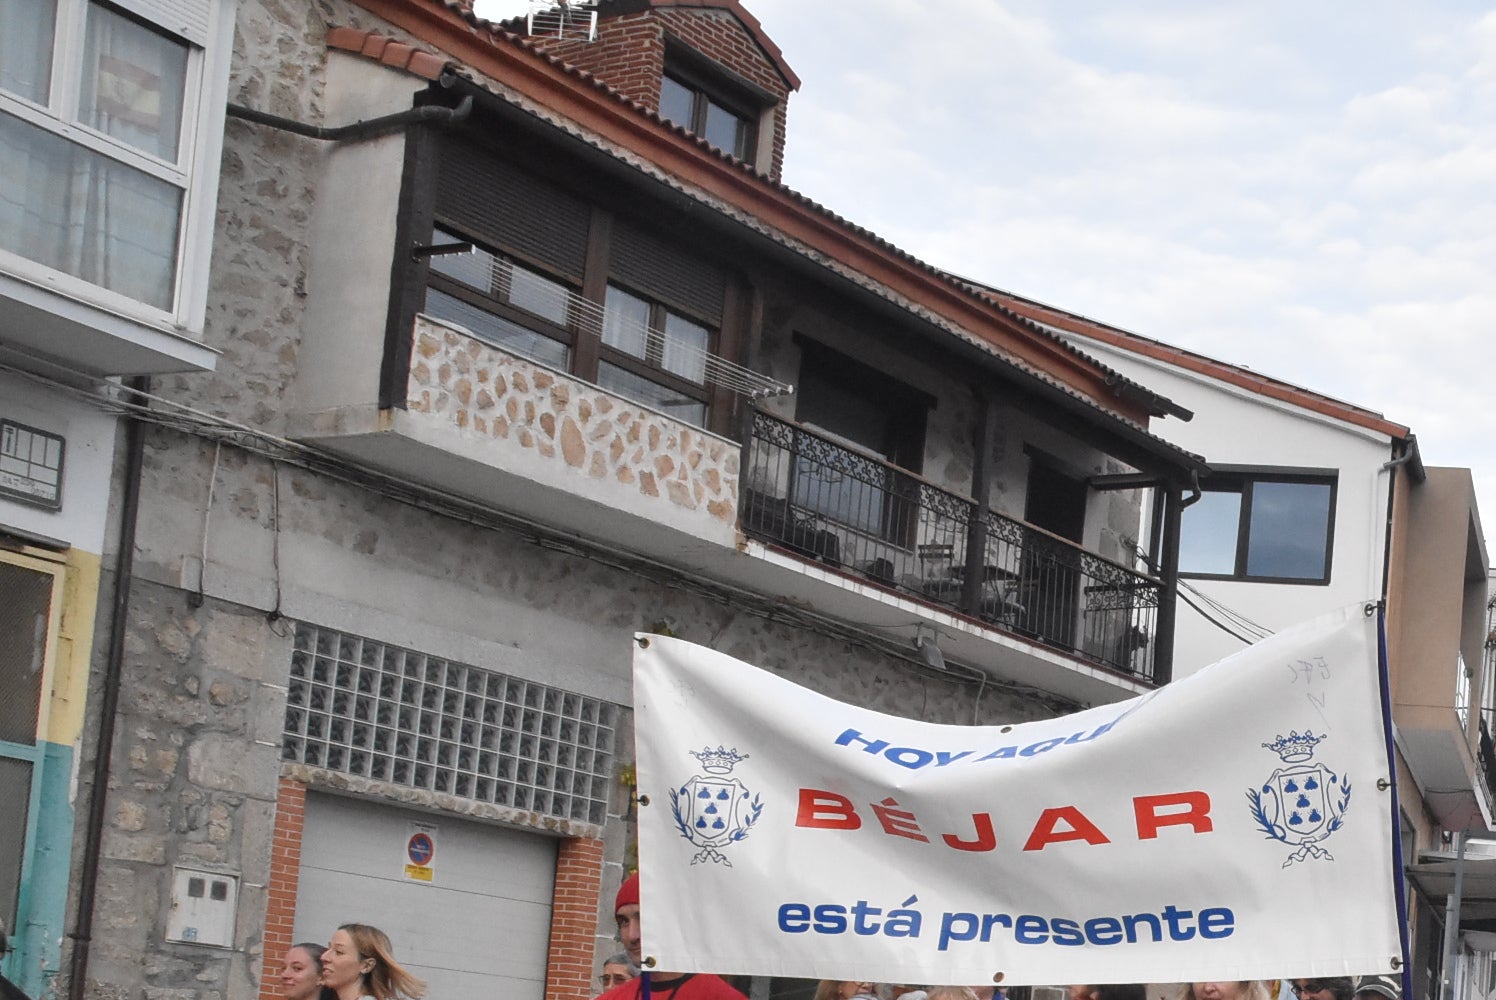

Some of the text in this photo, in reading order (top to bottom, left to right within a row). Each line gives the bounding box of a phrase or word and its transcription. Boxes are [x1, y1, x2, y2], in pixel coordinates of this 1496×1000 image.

[834, 728, 976, 770] HOY
[795, 788, 1214, 852] BÉJAR
[777, 894, 1236, 952] está presente
